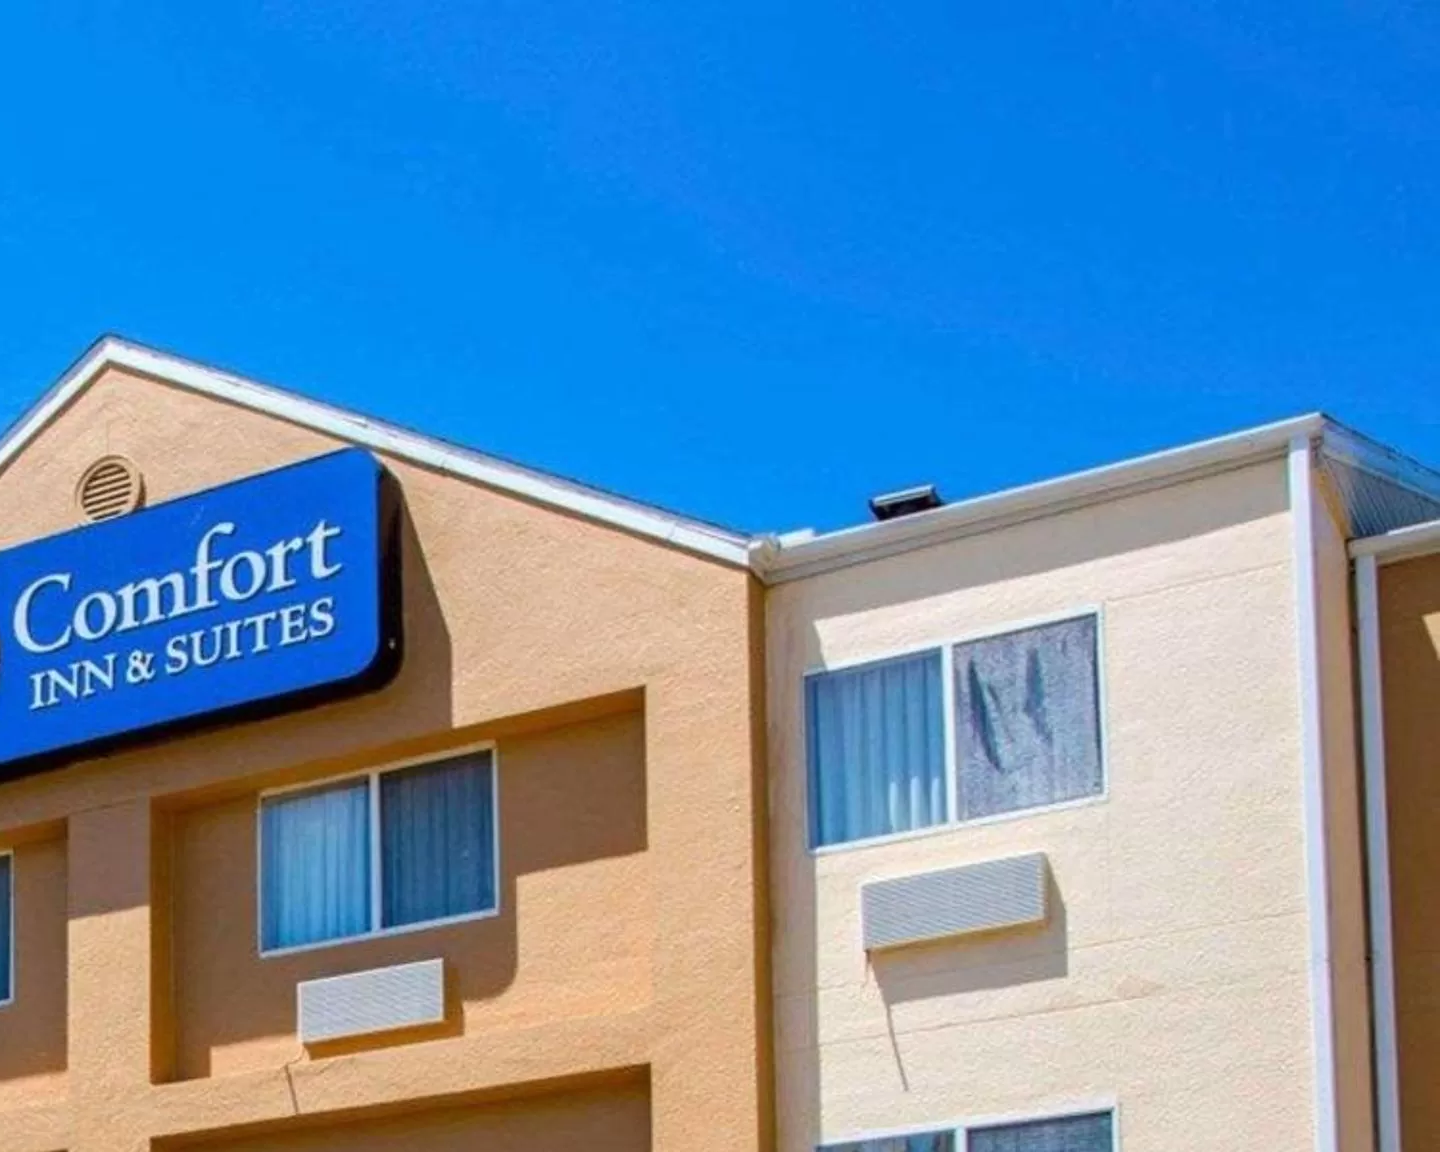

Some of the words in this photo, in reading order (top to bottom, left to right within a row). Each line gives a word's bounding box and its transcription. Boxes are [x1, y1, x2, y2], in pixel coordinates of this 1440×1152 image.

[13, 519, 341, 653] Comfort
[29, 654, 115, 709] INN
[126, 649, 155, 684] &
[165, 597, 335, 674] SUITES
